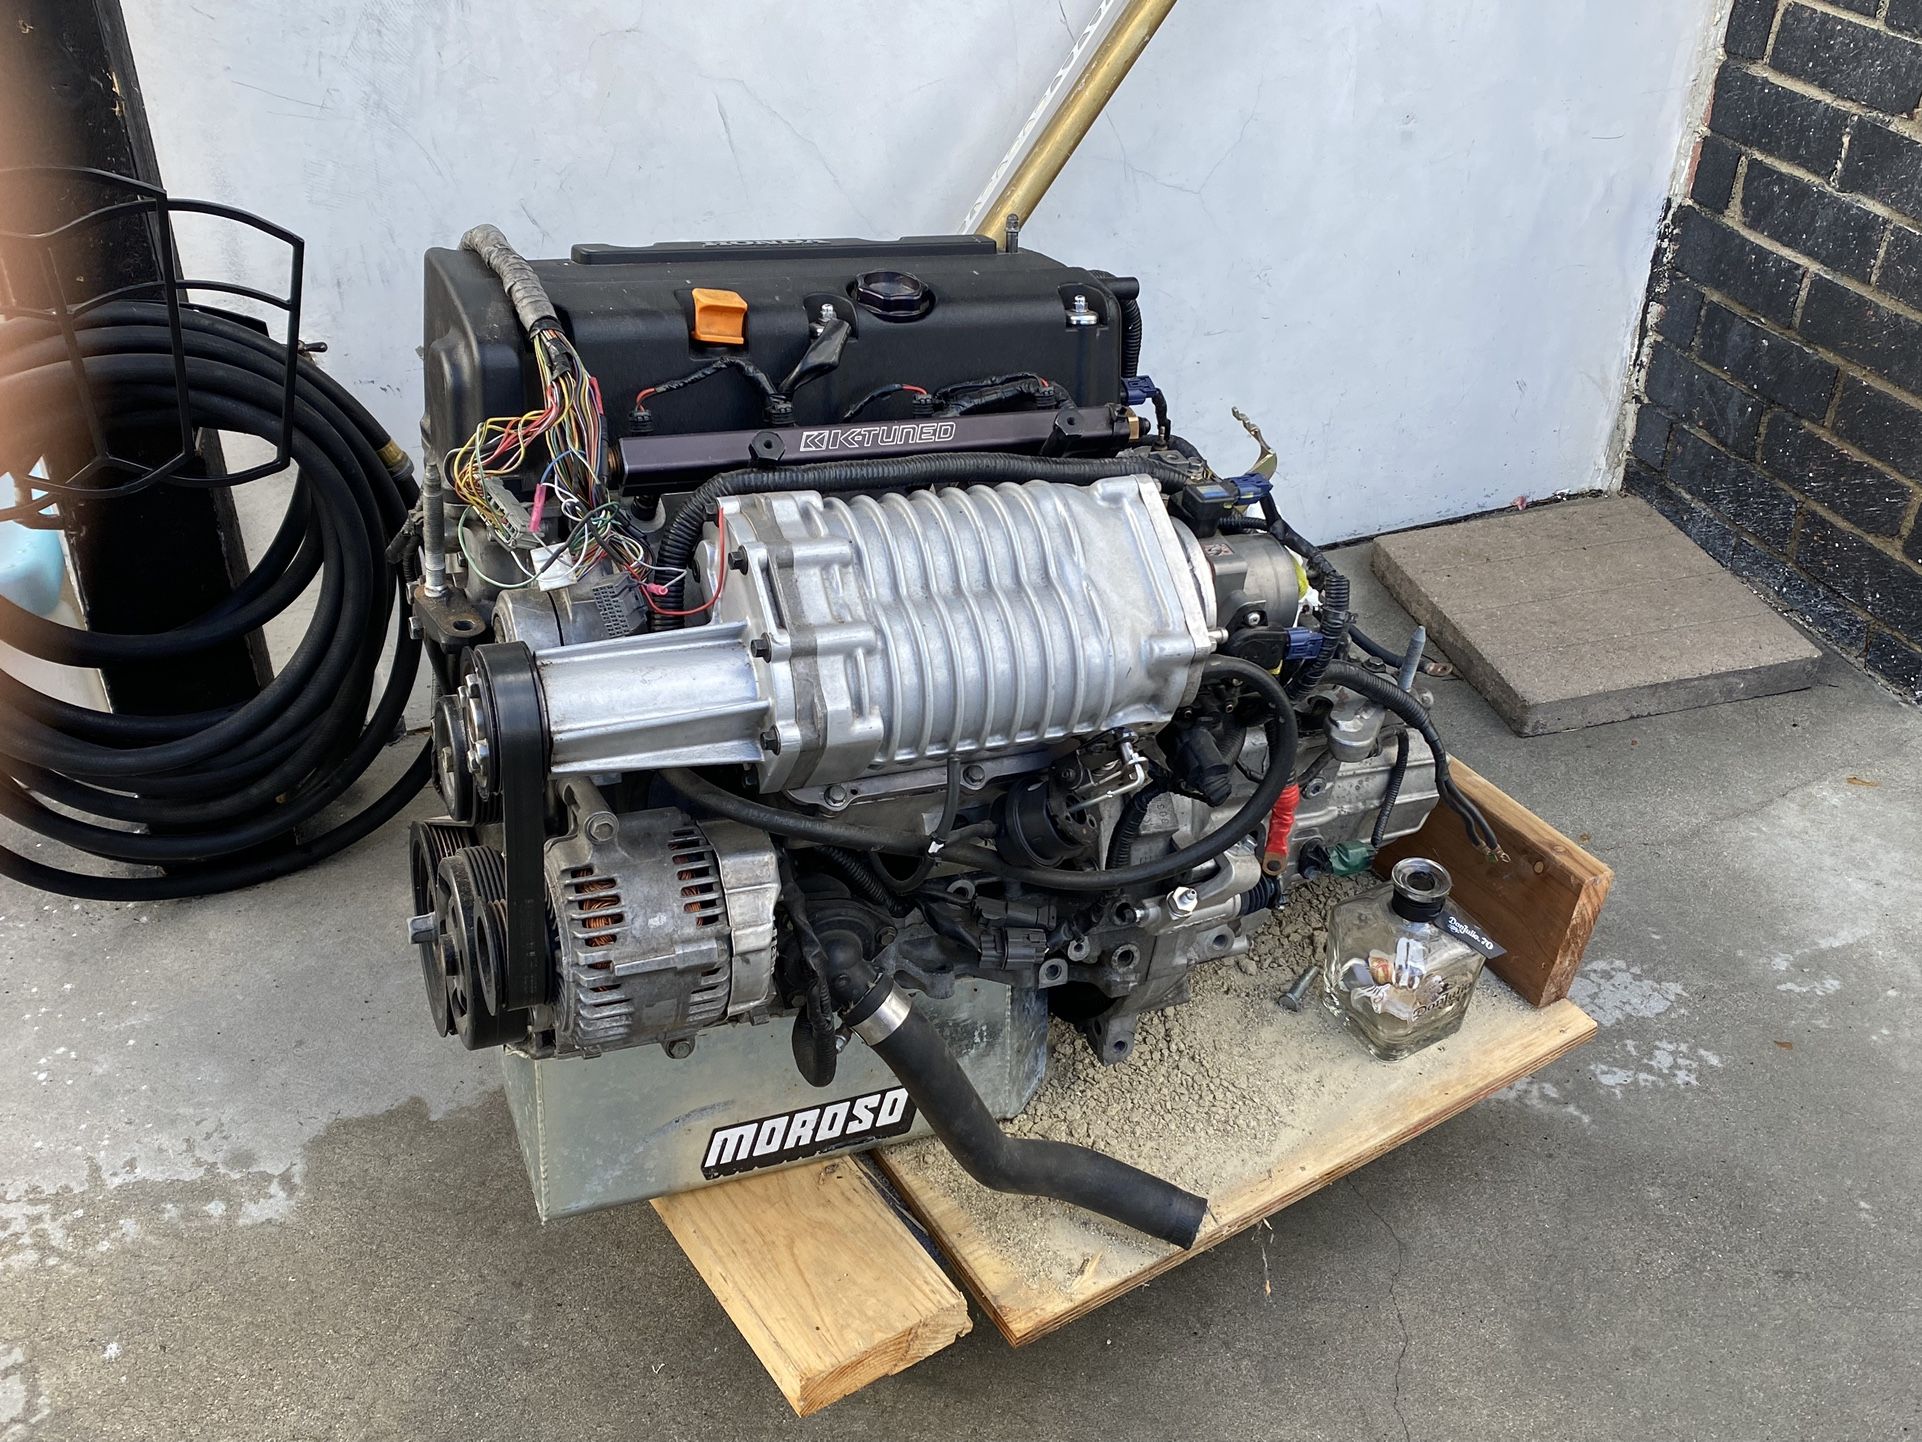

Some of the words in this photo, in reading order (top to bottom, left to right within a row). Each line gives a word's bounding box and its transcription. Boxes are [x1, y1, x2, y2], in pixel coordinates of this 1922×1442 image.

[703, 239, 831, 248] HONDA
[1481, 937, 1494, 950] 70
[704, 1087, 909, 1168] MOROSO
